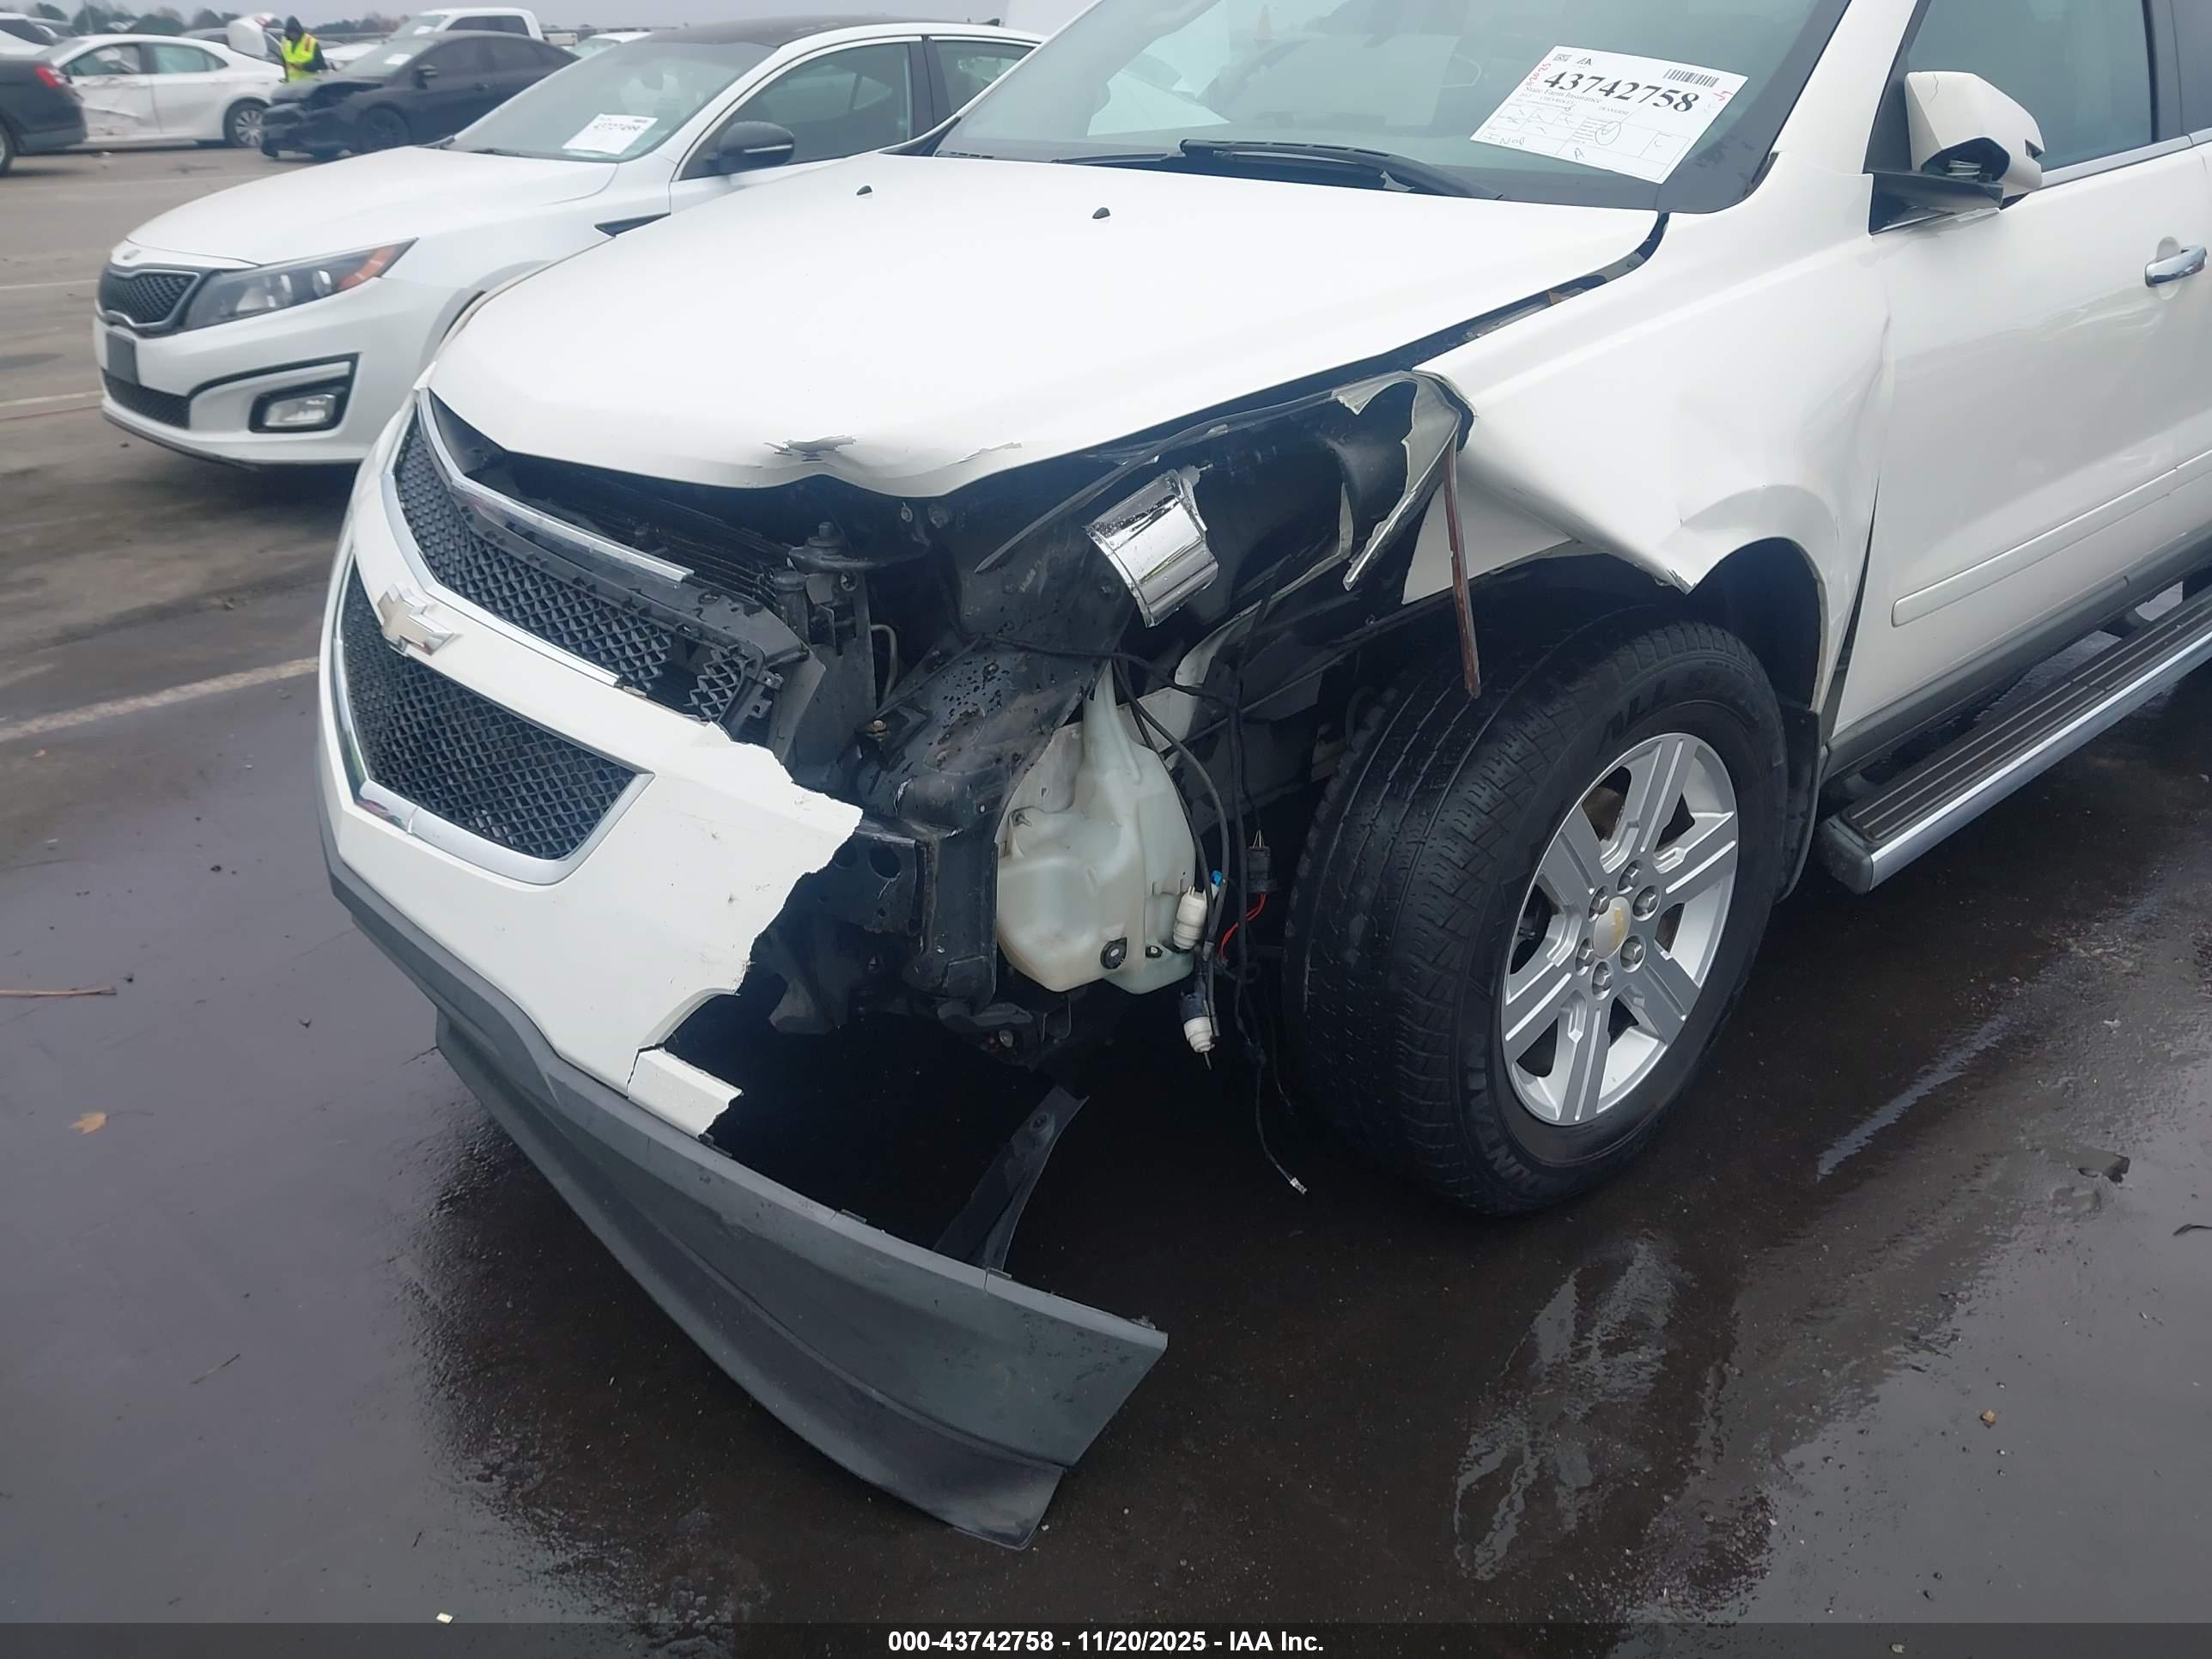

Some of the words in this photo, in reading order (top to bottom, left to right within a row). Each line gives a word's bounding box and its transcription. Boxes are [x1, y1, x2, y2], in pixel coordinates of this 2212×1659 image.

[1543, 70, 1700, 112] 43742758
[1544, 88, 1565, 98] Farm
[1565, 92, 1602, 104] Insurance
